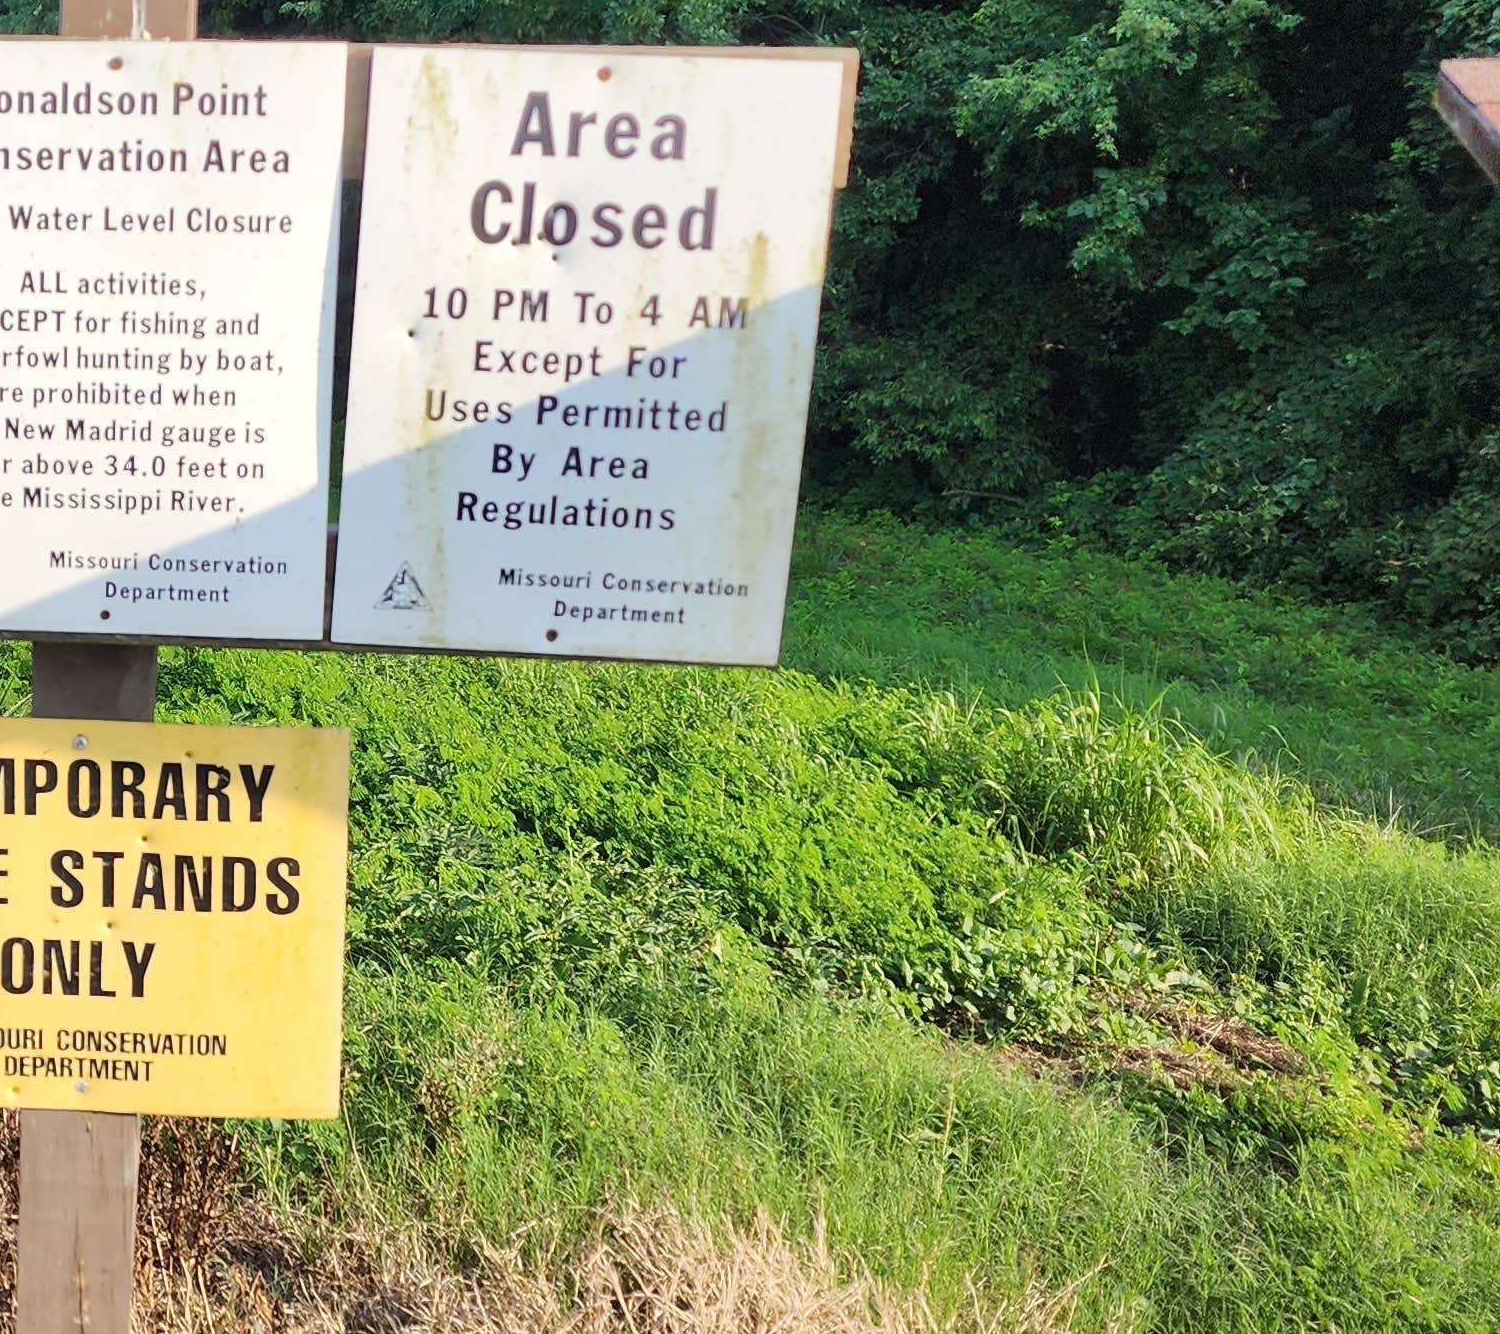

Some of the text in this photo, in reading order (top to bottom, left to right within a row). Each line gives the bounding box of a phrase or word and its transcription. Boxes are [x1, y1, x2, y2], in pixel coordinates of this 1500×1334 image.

[172, 83, 269, 117] Point
[510, 91, 688, 161] Area
[202, 140, 291, 174] Area
[8, 206, 93, 232] Water
[104, 208, 175, 233] Level
[186, 209, 293, 235] Closure
[470, 180, 719, 252] Closed
[20, 271, 207, 300] ALL activities,
[422, 287, 749, 330] 10 PM To 4 AM
[75, 310, 111, 334] for
[121, 311, 206, 340] fishing
[216, 313, 260, 337] and
[76, 347, 171, 374] hunting
[180, 348, 208, 375] by
[217, 349, 285, 375] boat,
[473, 340, 688, 383] Except For
[32, 384, 163, 408] prohibited
[172, 386, 237, 407] when
[425, 389, 728, 433] Uses Permitted
[5, 418, 56, 440] New
[65, 420, 153, 443] Madrid
[162, 424, 236, 449] gauge
[245, 423, 266, 444] is
[22, 454, 94, 476] above
[104, 454, 167, 477] 34.0
[177, 455, 227, 479] feet
[237, 460, 265, 479] on
[491, 443, 649, 481] By Area
[23, 487, 162, 514] Mississippi
[171, 490, 245, 513] River.
[456, 492, 677, 531] Regulations
[49, 550, 288, 575] Missouri Conservation
[105, 580, 230, 604] Department
[499, 569, 749, 597] Missouri Conservation
[554, 600, 686, 625] Department
[49, 848, 301, 915] STANDS
[0, 936, 156, 999] ONLY
[56, 1029, 227, 1055] CONSERVATION
[4, 1055, 154, 1082] DEPARTMENT
